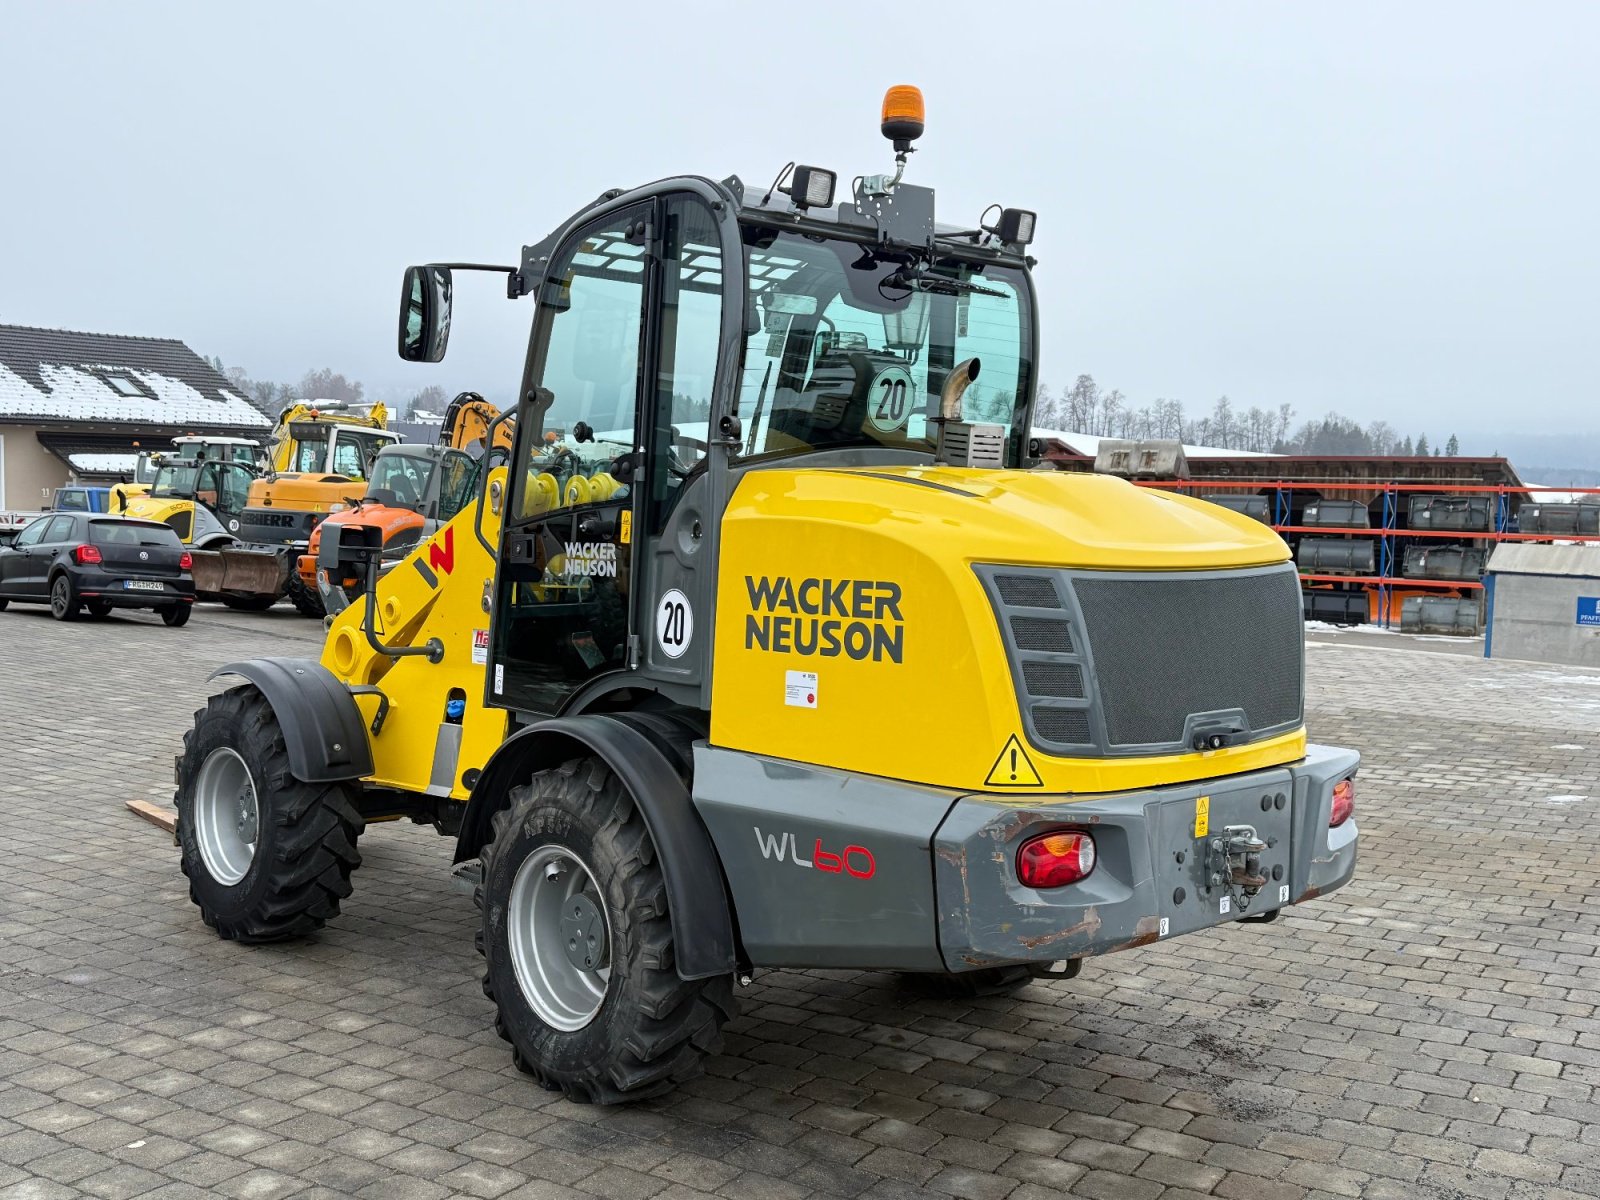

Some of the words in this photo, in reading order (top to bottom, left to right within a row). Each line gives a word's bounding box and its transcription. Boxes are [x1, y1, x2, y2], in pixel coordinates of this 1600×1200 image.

[876, 378, 906, 420] 20
[564, 541, 617, 560] WACKER
[565, 558, 617, 578] NEUSON
[745, 575, 904, 621] WACKER
[663, 601, 685, 646] 20
[745, 614, 904, 664] NEUSON
[753, 826, 877, 880] WL60
